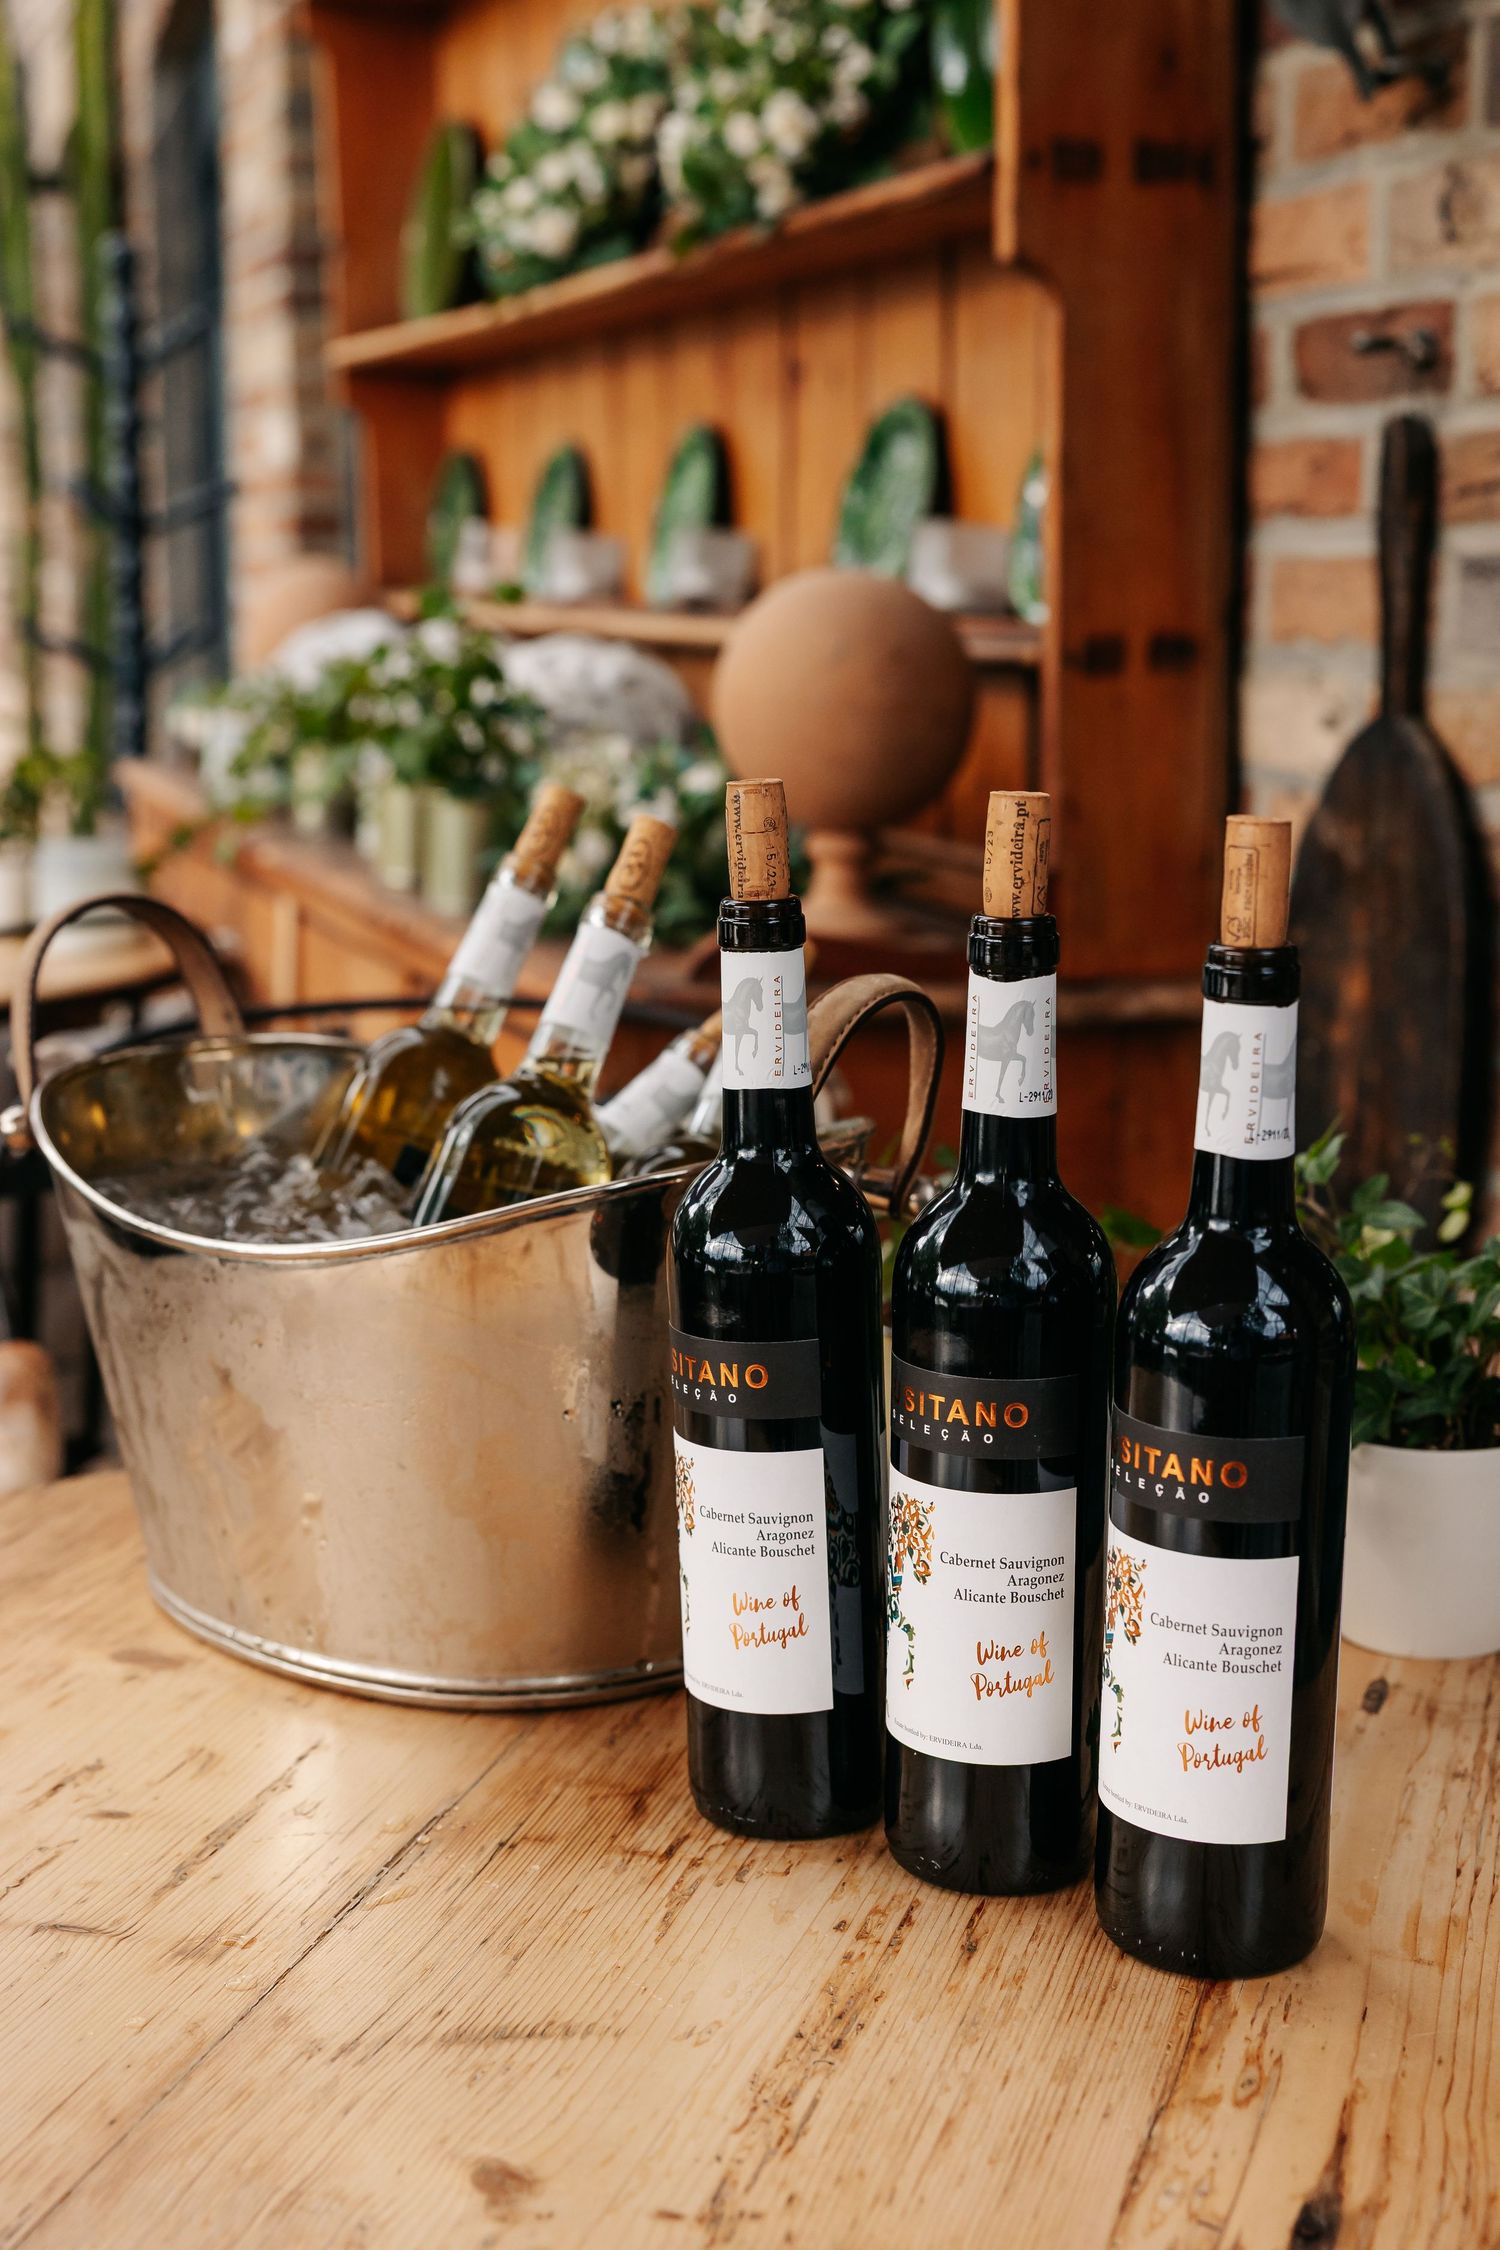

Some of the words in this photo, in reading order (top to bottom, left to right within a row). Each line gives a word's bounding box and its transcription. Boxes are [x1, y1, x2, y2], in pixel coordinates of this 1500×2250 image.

[774, 975, 782, 1077] ERVIDEIRA
[968, 994, 978, 1099] ERVIDEIRA
[1043, 997, 1052, 1104] ERVIDEIRA
[1244, 1032, 1262, 1145] ERVIDEIRA
[903, 1385, 1029, 1429] SITANO
[1119, 1435, 1248, 1489] SITANO
[699, 1504, 745, 1524] Cabernet
[748, 1511, 814, 1528] Sauvignon
[711, 1541, 757, 1558] Alicante
[760, 1544, 815, 1558] Bouschet
[756, 1529, 815, 1544] Aragonez
[940, 1551, 996, 1570] Cabernet
[999, 1554, 1065, 1572] Sauvignon
[953, 1588, 1006, 1604] Alicante
[1010, 1587, 1065, 1604] Bouschet
[1007, 1573, 1065, 1589] Aragonez
[731, 1591, 776, 1616] Wine
[782, 1585, 801, 1611] of
[729, 1612, 809, 1650] Portugal
[1150, 1612, 1207, 1636] Cabernet
[1211, 1623, 1283, 1642] Sauvignon
[976, 1640, 1024, 1666] Wine
[1030, 1631, 1049, 1658] of
[1163, 1652, 1218, 1673] Alicante
[1222, 1659, 1283, 1675] Bouschet
[1219, 1643, 1283, 1659] Aragonez
[970, 1659, 1055, 1701] Portugal
[1184, 1709, 1236, 1735] Wine
[1243, 1704, 1263, 1733] of
[929, 1735, 968, 1749] ERVIDEIRA
[1177, 1734, 1268, 1774] Portugal
[1133, 1802, 1172, 1821] ERVIDEIRA
